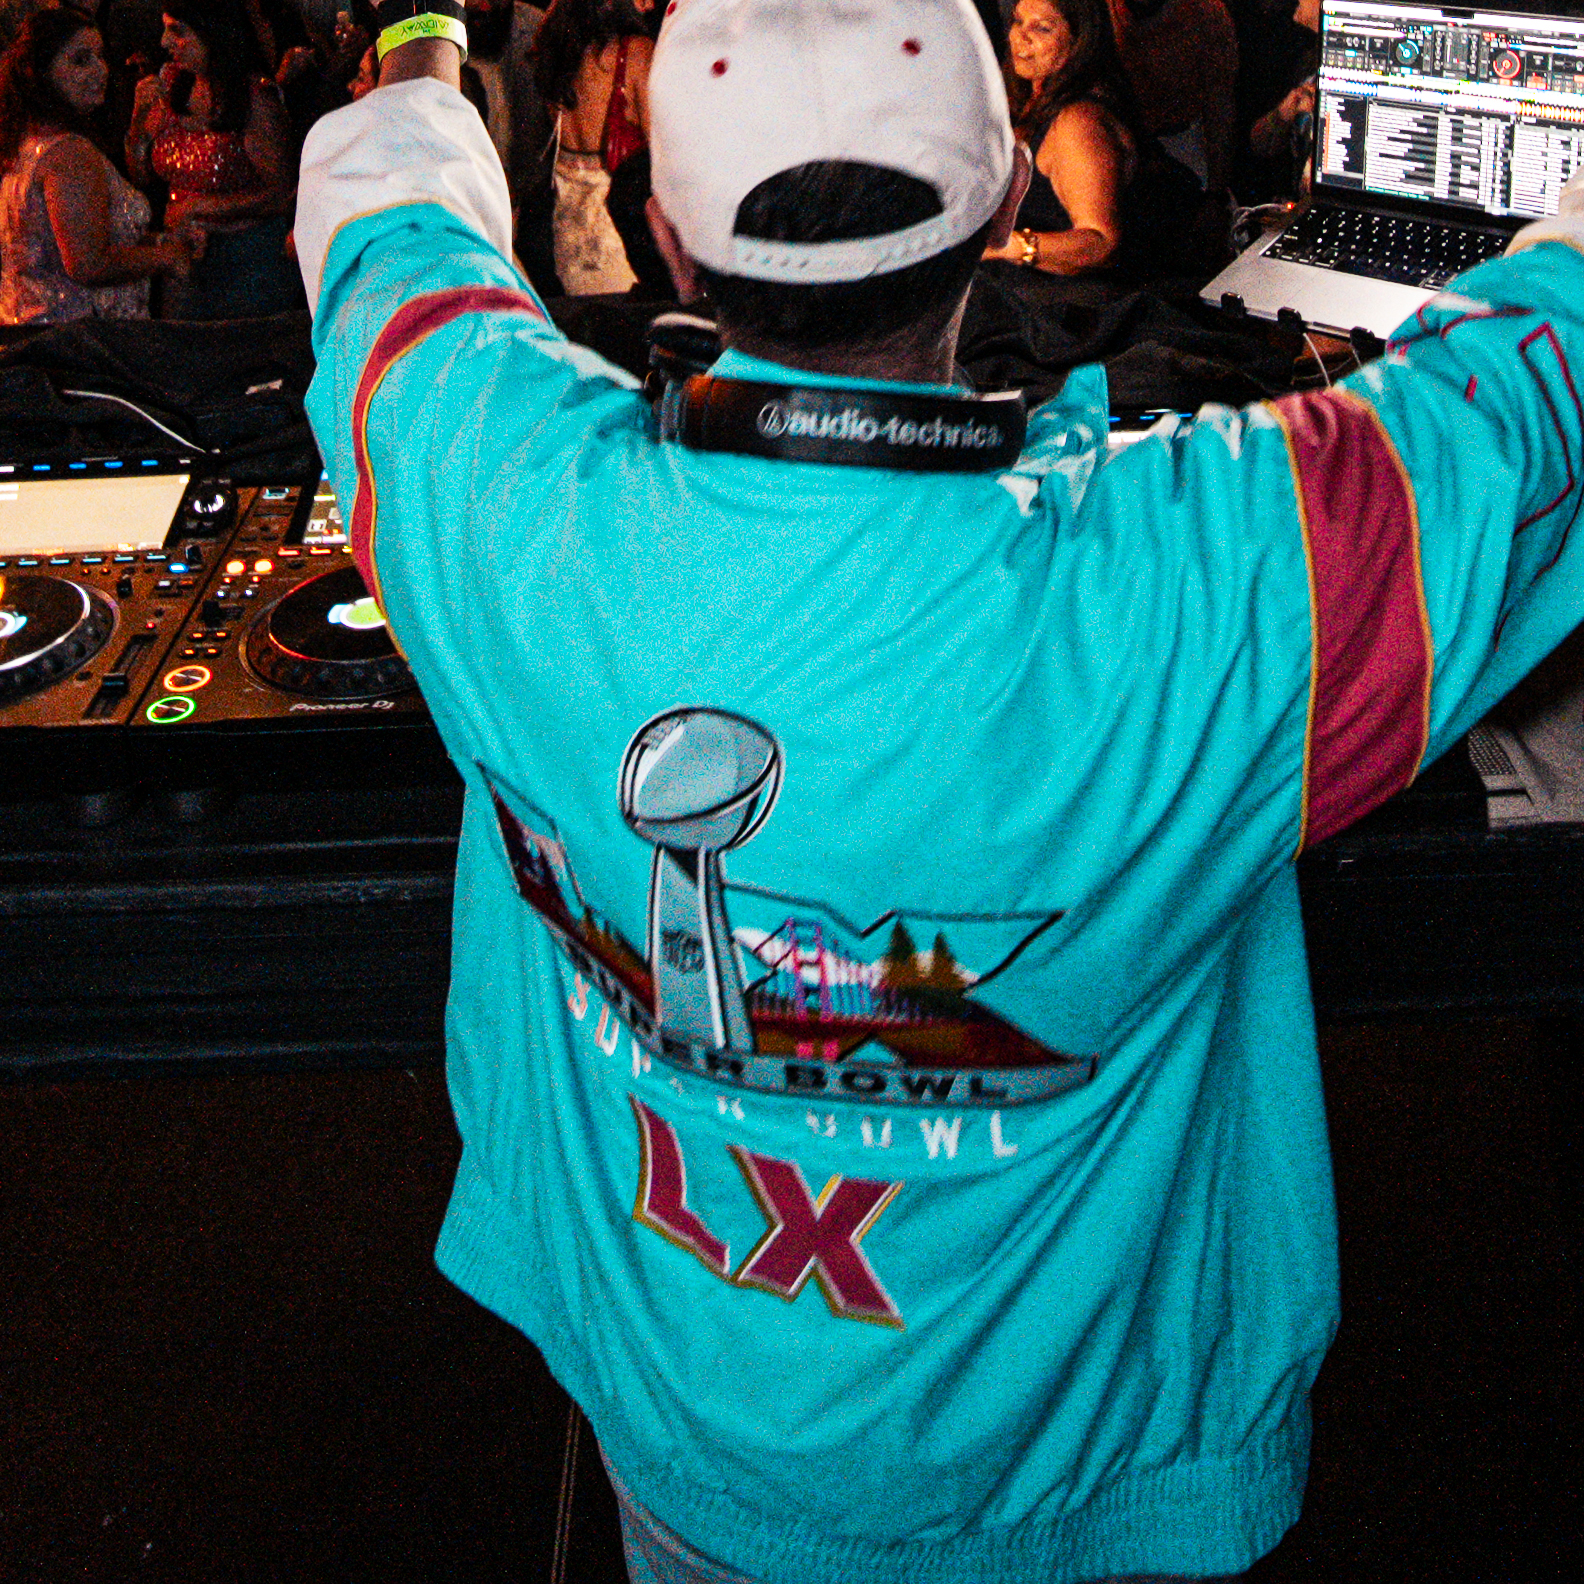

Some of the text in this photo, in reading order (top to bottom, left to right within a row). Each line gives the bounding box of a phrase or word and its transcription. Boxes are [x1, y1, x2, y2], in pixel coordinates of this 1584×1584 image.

[790, 409, 1002, 448] audio-technica
[785, 1064, 1008, 1100] BOWL
[626, 1093, 904, 1329] LX
